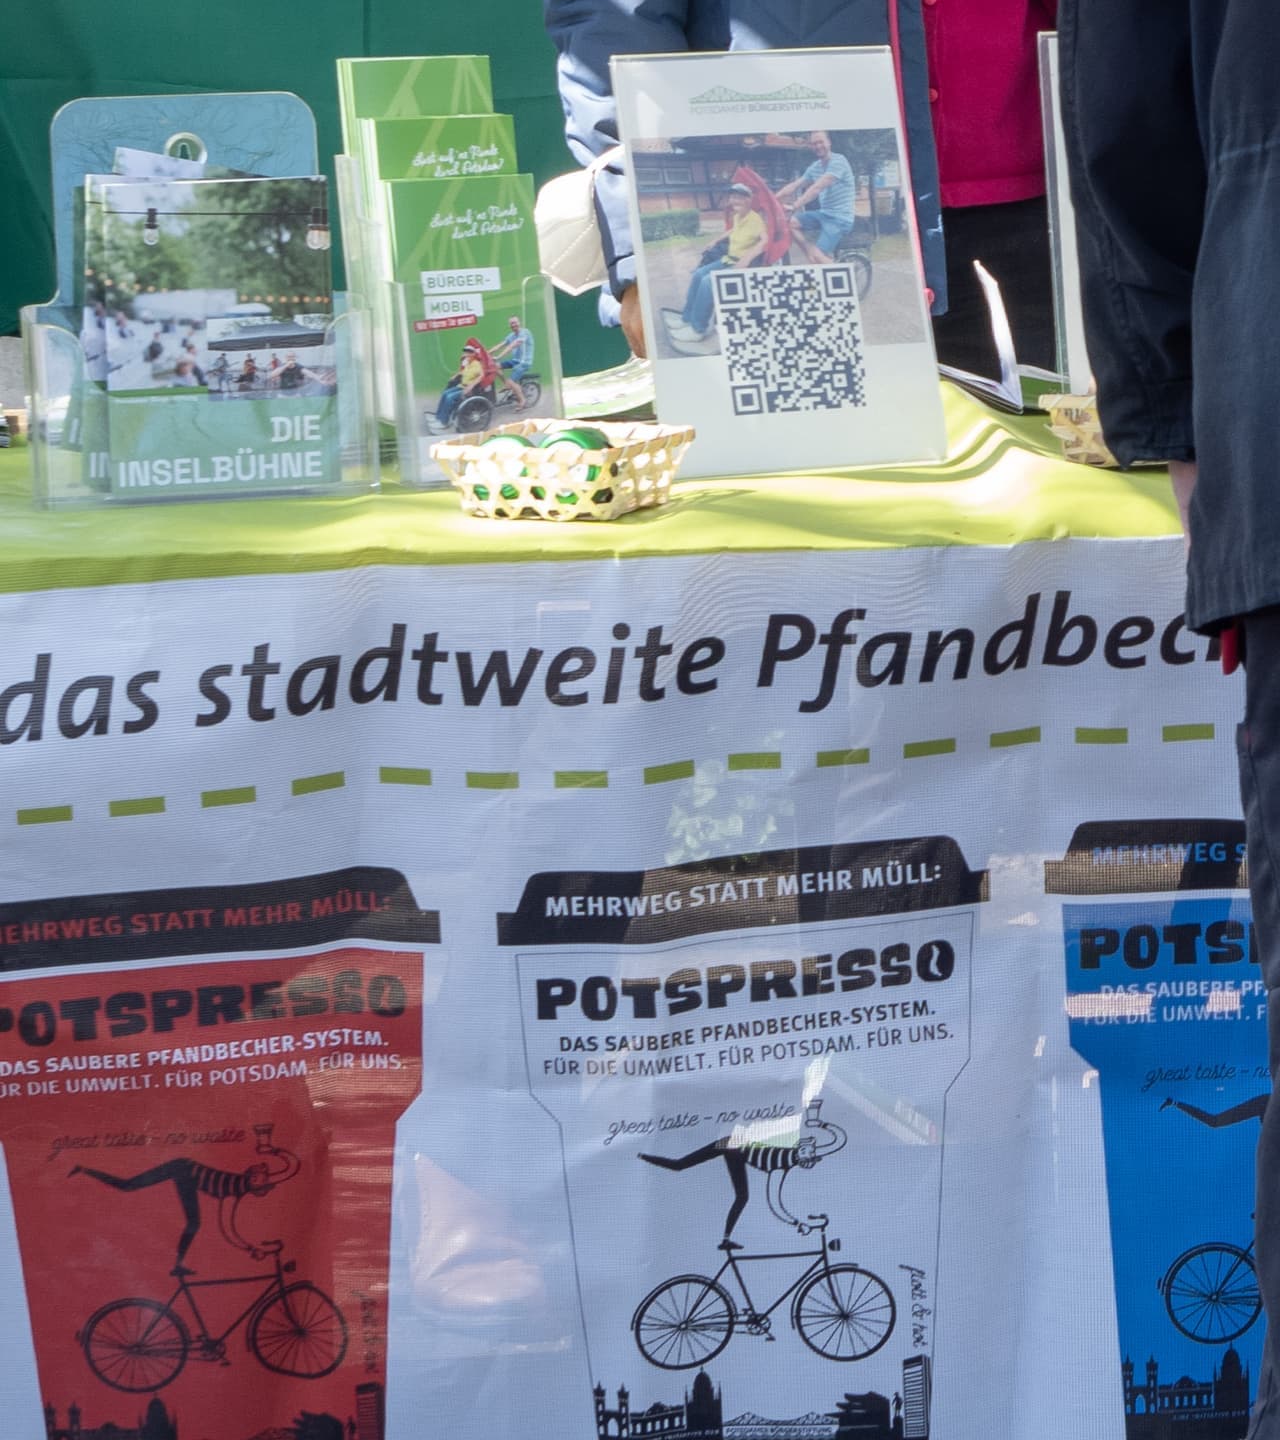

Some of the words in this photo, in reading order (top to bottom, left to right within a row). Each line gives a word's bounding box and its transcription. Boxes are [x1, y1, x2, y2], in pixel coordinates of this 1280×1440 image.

[427, 273, 490, 289] BÜRGER-
[430, 300, 473, 314] MOBIL
[269, 415, 322, 442] DIE
[119, 447, 323, 488] INSELBÜHNE
[0, 652, 160, 746] das
[195, 622, 726, 730] stadtweite
[1092, 843, 1226, 865] MEHRWEG
[131, 909, 214, 935] STATT
[224, 901, 301, 927] MEHR
[311, 889, 392, 918] MÜLL:
[545, 892, 681, 918] MEHRWEG
[689, 877, 769, 908] STATT
[777, 869, 852, 897] MEHR
[862, 862, 942, 889] MÜLL:
[536, 940, 955, 1021] POTSPRESSO
[1145, 981, 1236, 999] SAUBERE
[559, 1035, 599, 1053] DAS
[604, 1028, 696, 1053] SAUBERE
[701, 1000, 936, 1044] PFANDBECHER-SYSTEM.
[45, 1052, 142, 1074] SAUBERE
[148, 1028, 389, 1066] PFANDBECHER-SYSTEM.
[543, 1057, 580, 1077] FÜR
[587, 1057, 617, 1076] DIE
[623, 1053, 713, 1076] UMWELT.
[718, 1045, 754, 1068] FÜR
[761, 1034, 861, 1062] POTSDAM.
[867, 1026, 902, 1049] FÜR
[909, 1023, 954, 1044] UNS.
[27, 1078, 61, 1097] DIE
[66, 1072, 160, 1094] UMWELT.
[165, 1067, 202, 1089] FÜR
[210, 1059, 311, 1086] POTSDAM.
[319, 1052, 355, 1072] FÜR
[365, 1052, 407, 1071] UNS.
[1141, 1064, 1192, 1093] great
[1196, 1062, 1236, 1081] taste
[603, 1118, 656, 1146] great
[657, 1111, 700, 1132] taste
[716, 1110, 740, 1124] no
[743, 1102, 796, 1122] waste
